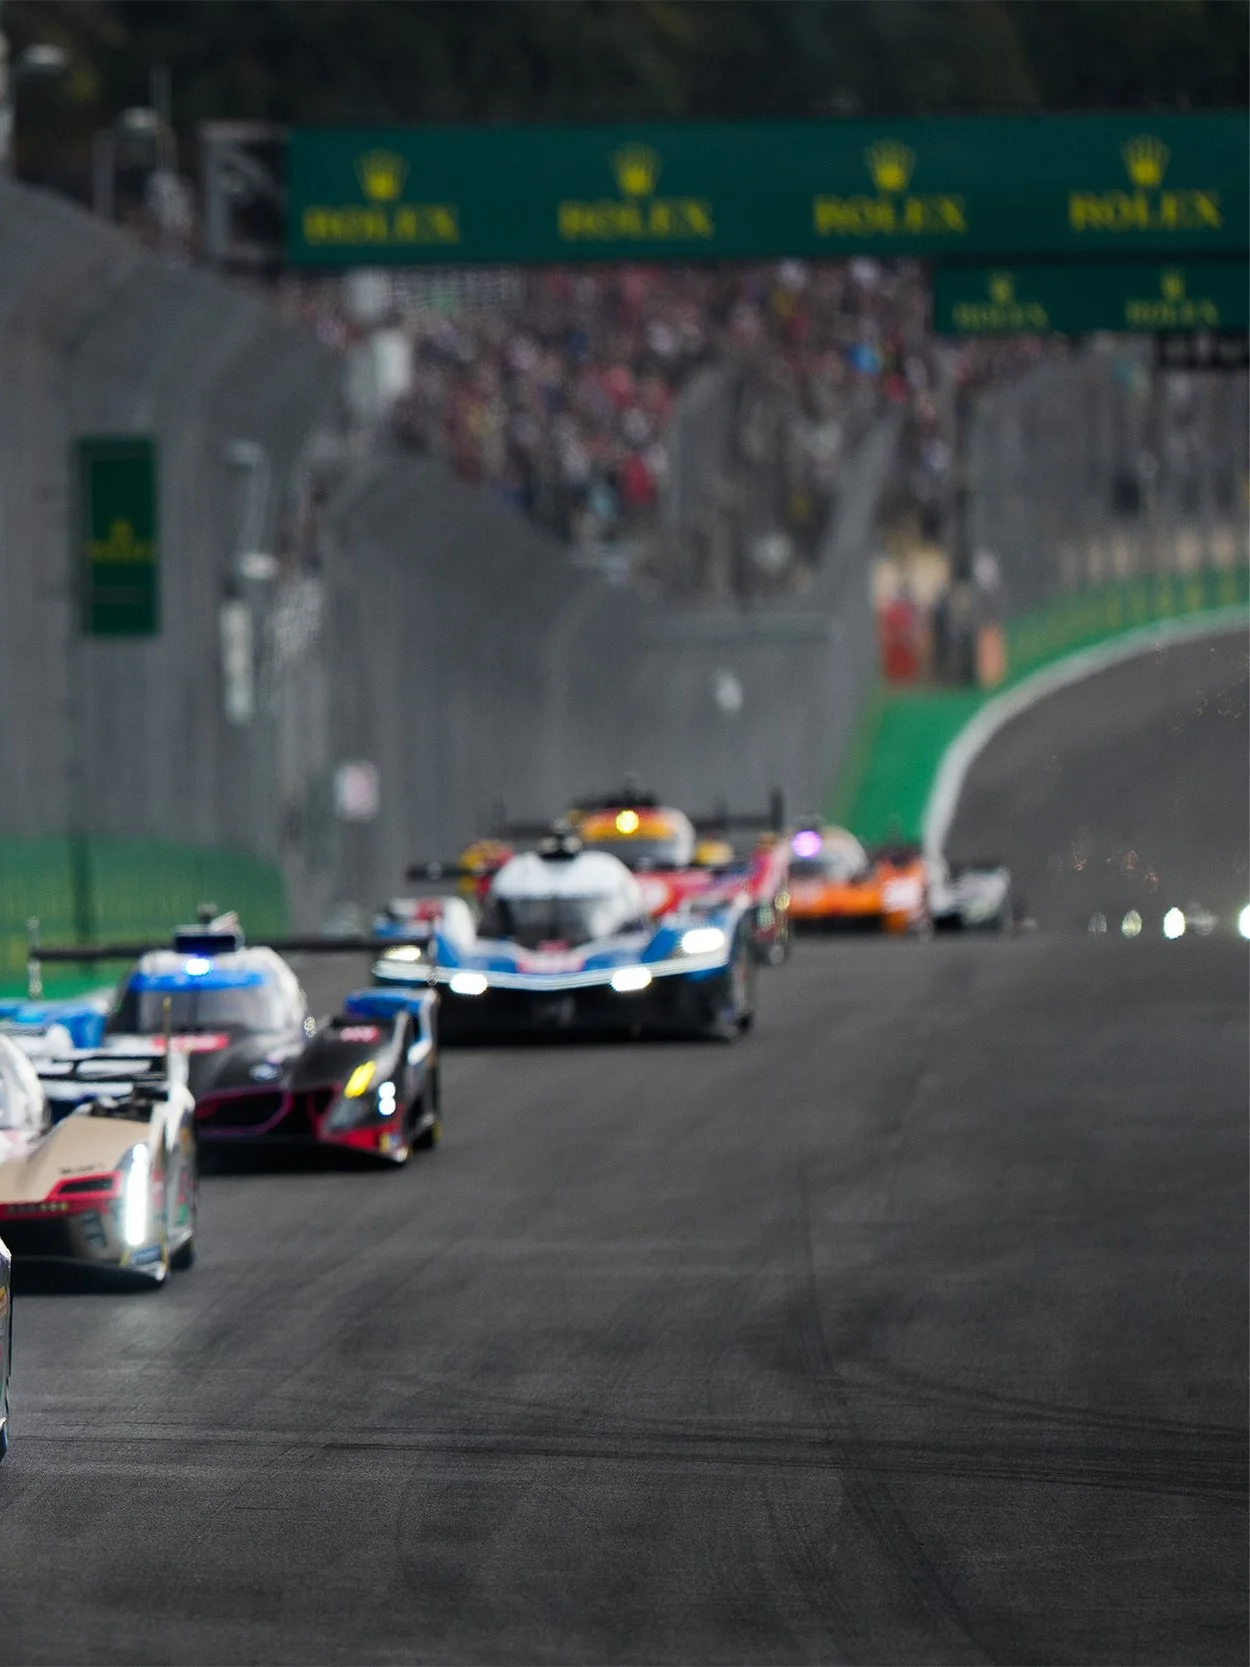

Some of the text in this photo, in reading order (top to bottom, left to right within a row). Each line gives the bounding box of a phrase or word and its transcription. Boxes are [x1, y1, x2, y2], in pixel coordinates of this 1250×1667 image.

[304, 206, 459, 244] ROLEX
[559, 200, 713, 239] ROLEX
[815, 195, 965, 235] ROLEX
[1069, 190, 1221, 230] ROLEX
